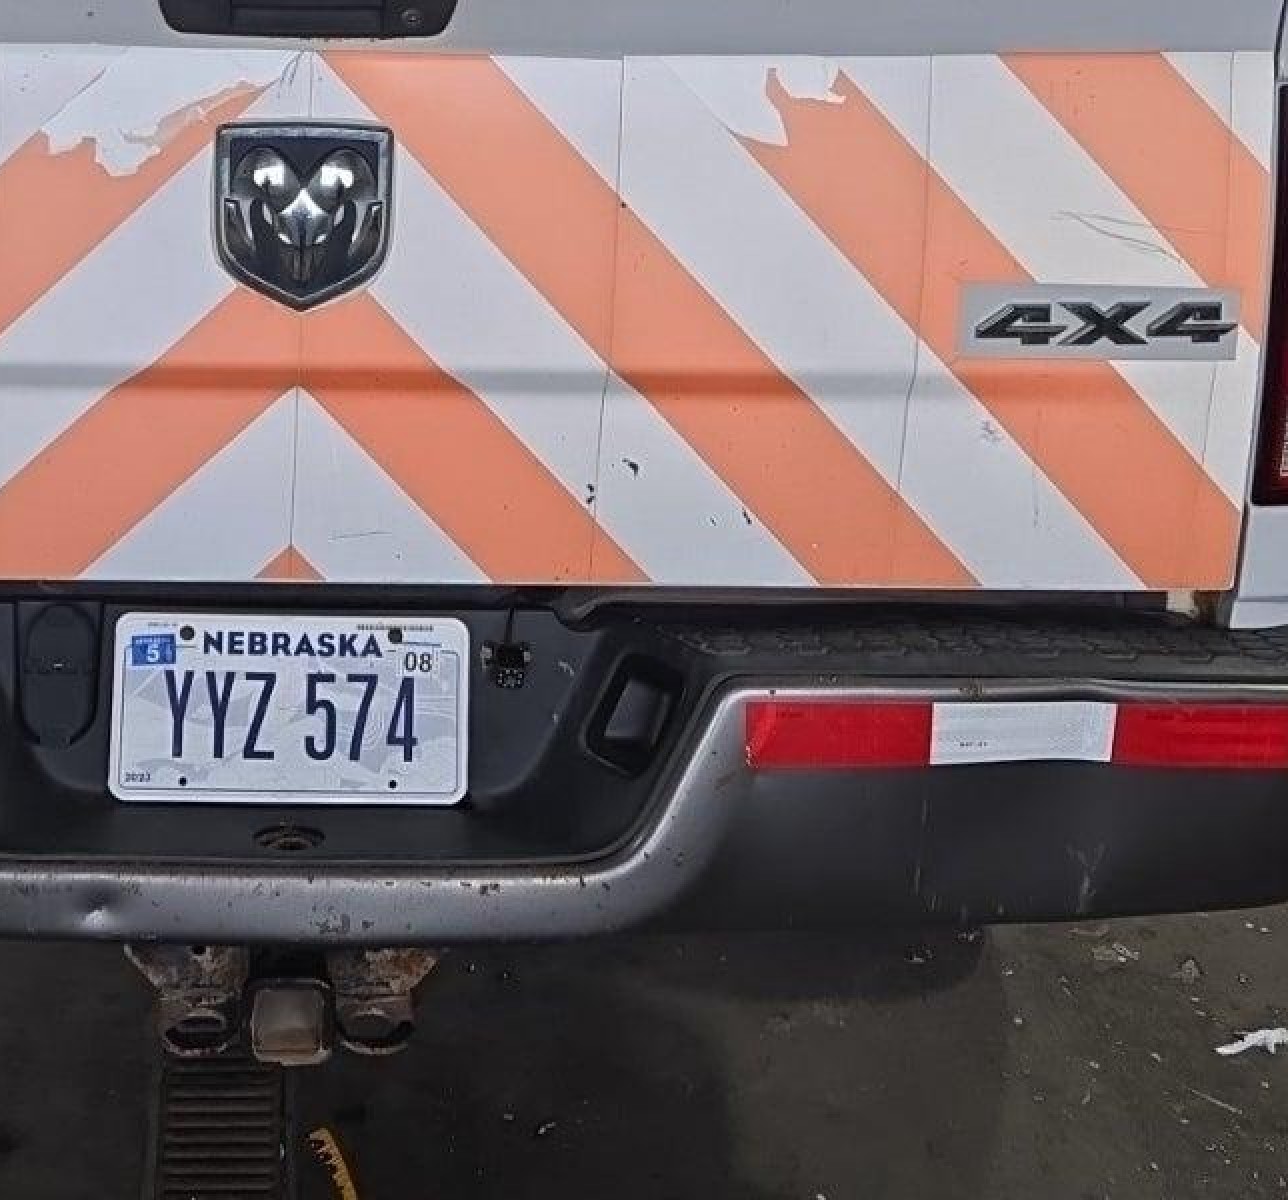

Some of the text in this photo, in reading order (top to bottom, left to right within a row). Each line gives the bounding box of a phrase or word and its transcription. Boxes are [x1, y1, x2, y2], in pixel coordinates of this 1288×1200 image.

[146, 644, 160, 663] 5
[203, 631, 383, 658] NEBRASKA
[404, 652, 433, 672] 08
[165, 670, 418, 763] YYZ 574
